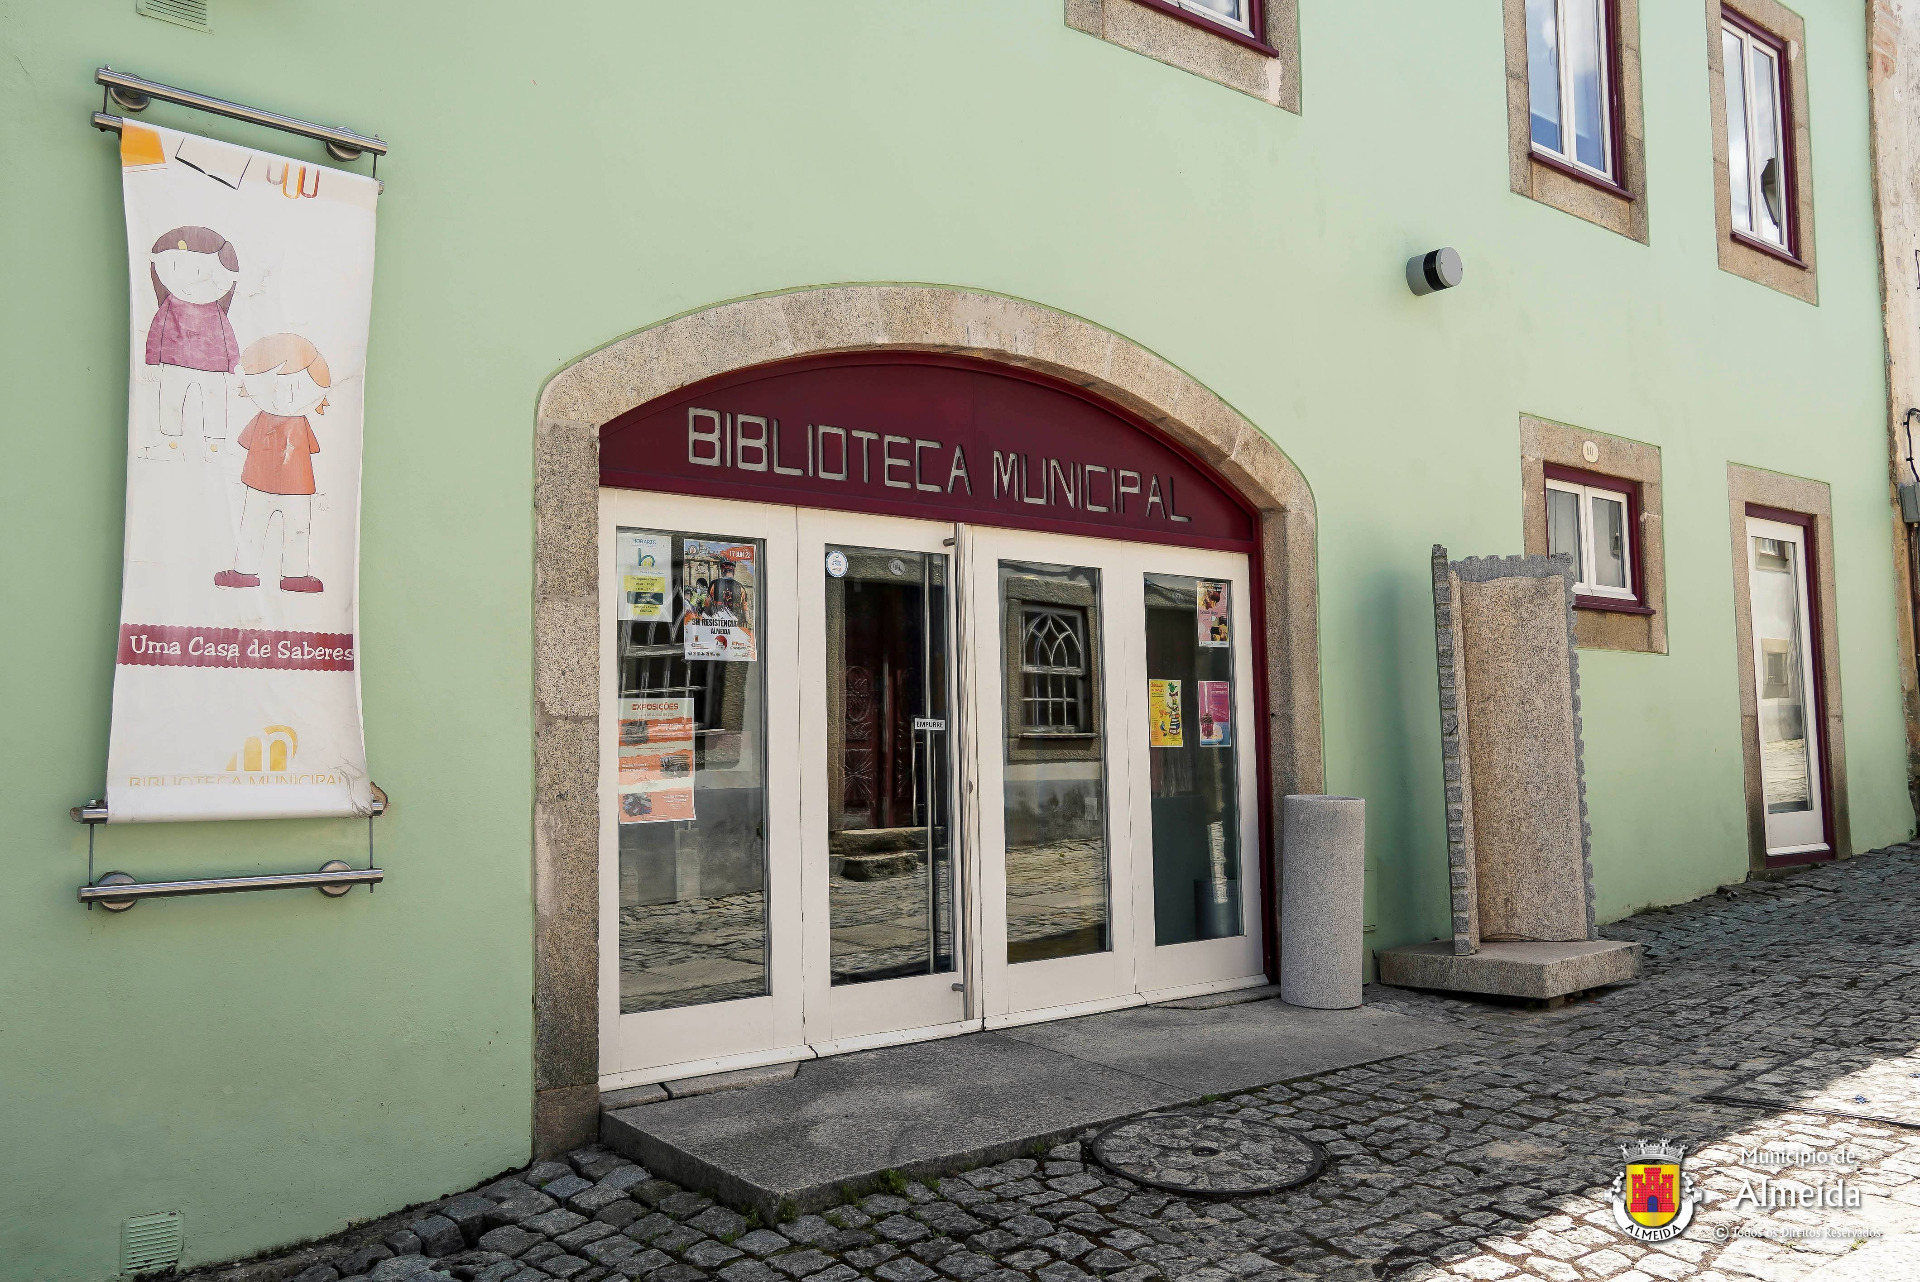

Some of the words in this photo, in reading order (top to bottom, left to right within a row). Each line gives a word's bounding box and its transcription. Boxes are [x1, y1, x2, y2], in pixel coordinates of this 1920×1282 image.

[687, 406, 973, 496] BIBLIOTECA
[993, 449, 1193, 523] MUNICIPAL
[130, 634, 182, 655] Uma
[189, 636, 240, 657] Casa
[247, 639, 271, 658] de
[277, 641, 354, 661] Saberes
[632, 701, 679, 712] EXPOSIÇÕES
